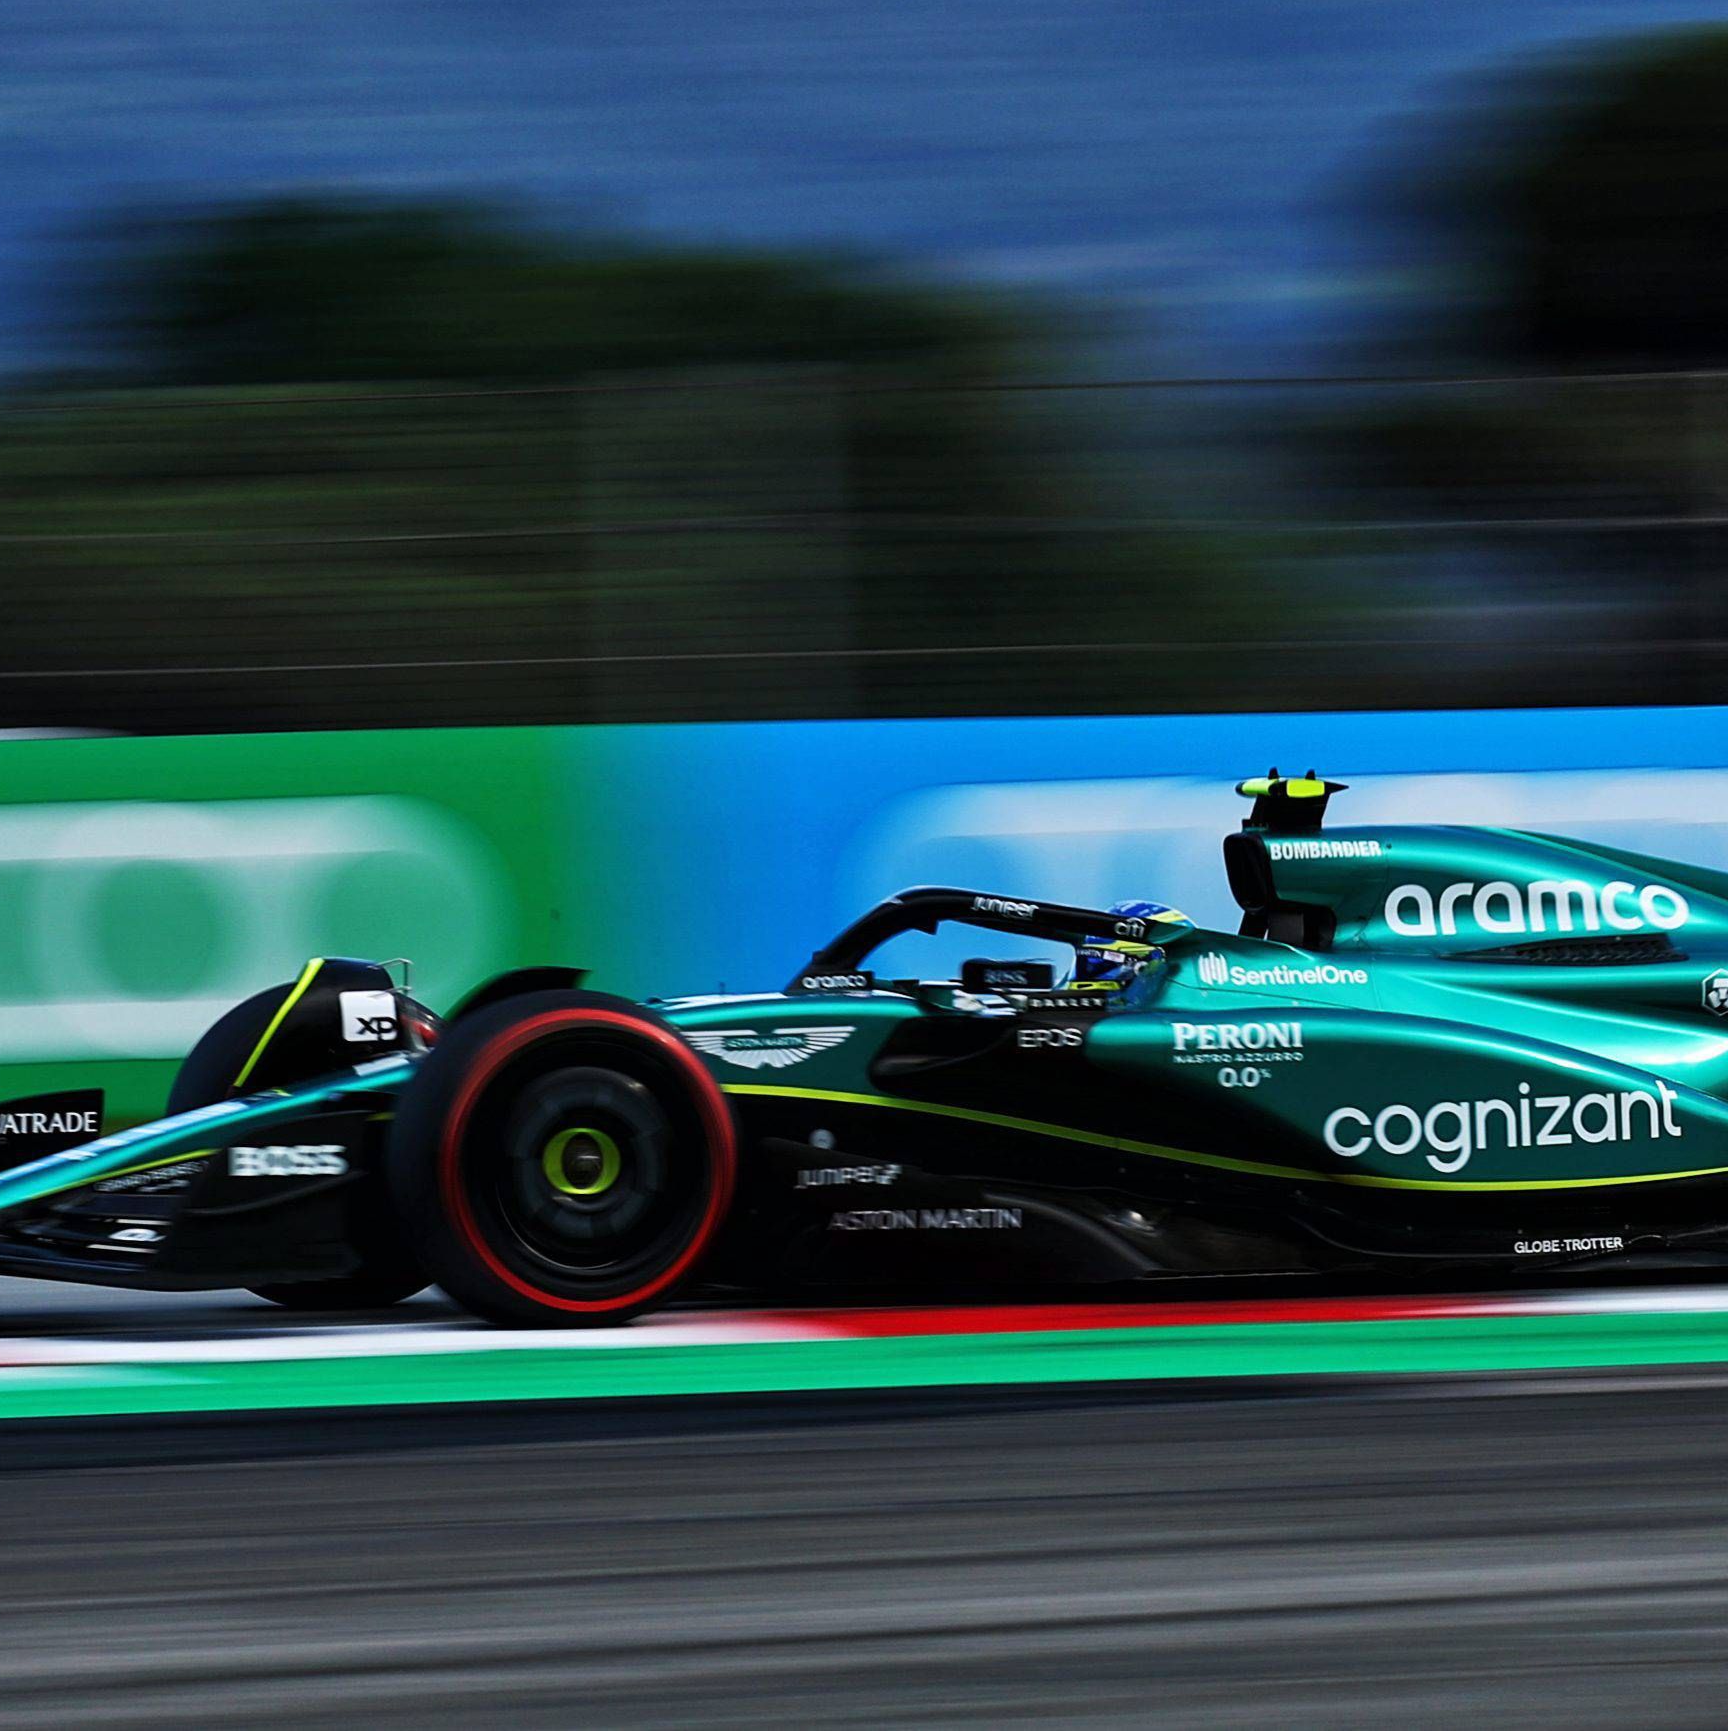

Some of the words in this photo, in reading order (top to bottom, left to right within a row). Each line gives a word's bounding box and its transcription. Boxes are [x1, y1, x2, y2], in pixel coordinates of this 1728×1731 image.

[1270, 840, 1382, 861] BOMBARDIER
[1384, 878, 1690, 937] aramco
[1115, 917, 1146, 938] citi
[802, 975, 867, 989] aramco
[1230, 965, 1368, 985] SentinelOne
[1017, 1027, 1083, 1048] EPOS
[1171, 1022, 1304, 1050] PERONI
[1323, 1080, 1682, 1173] cognizant
[229, 1144, 349, 1176] BOSS
[827, 1210, 917, 1230] ASTON
[923, 1208, 1022, 1229] MARTIN
